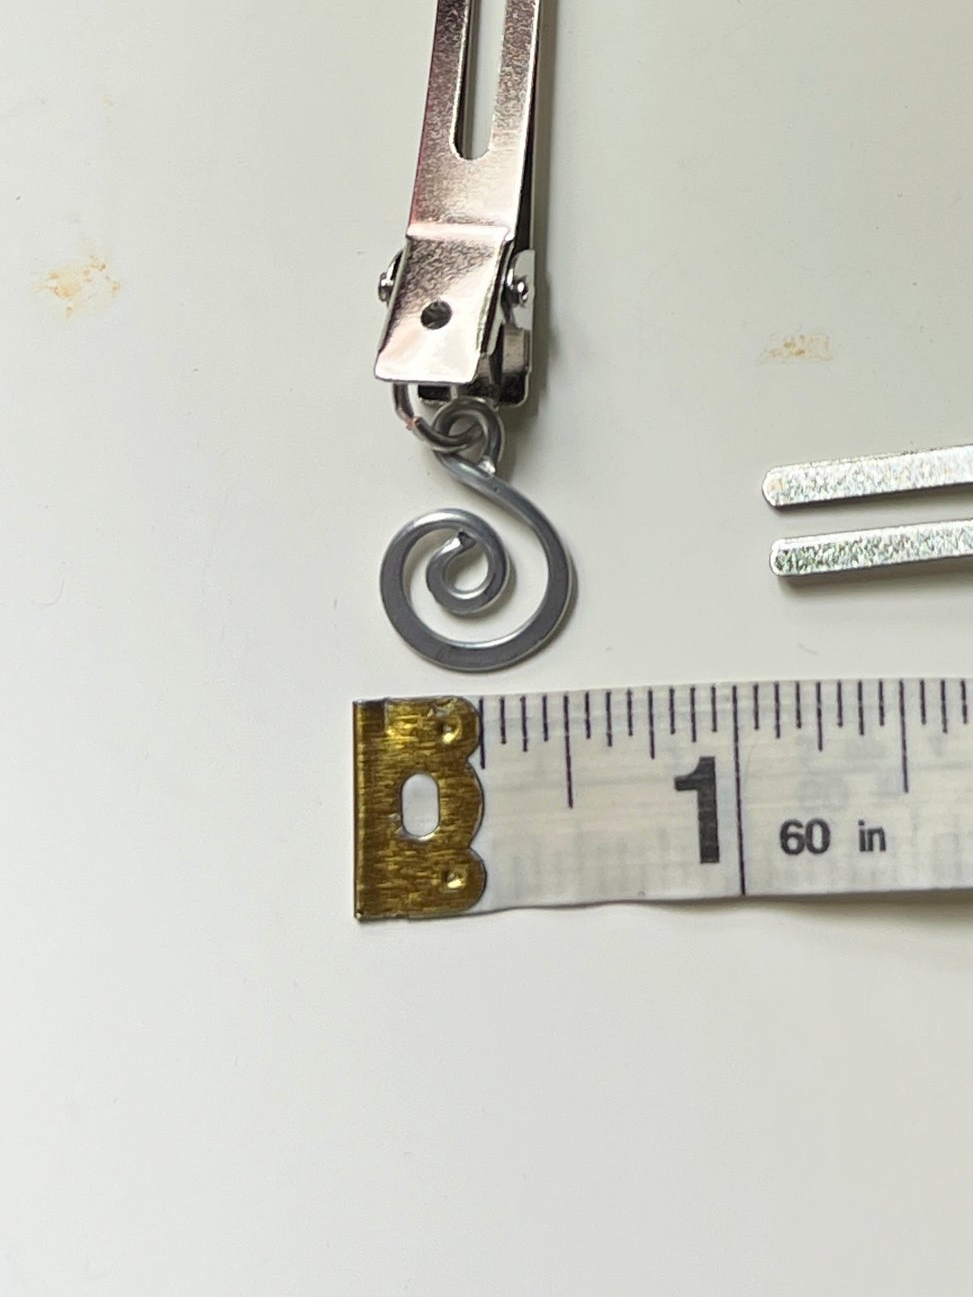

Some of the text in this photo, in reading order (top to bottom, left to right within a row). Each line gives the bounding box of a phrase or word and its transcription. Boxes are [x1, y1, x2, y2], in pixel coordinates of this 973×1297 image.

[674, 755, 721, 864] 1
[779, 818, 886, 856] 60 in
